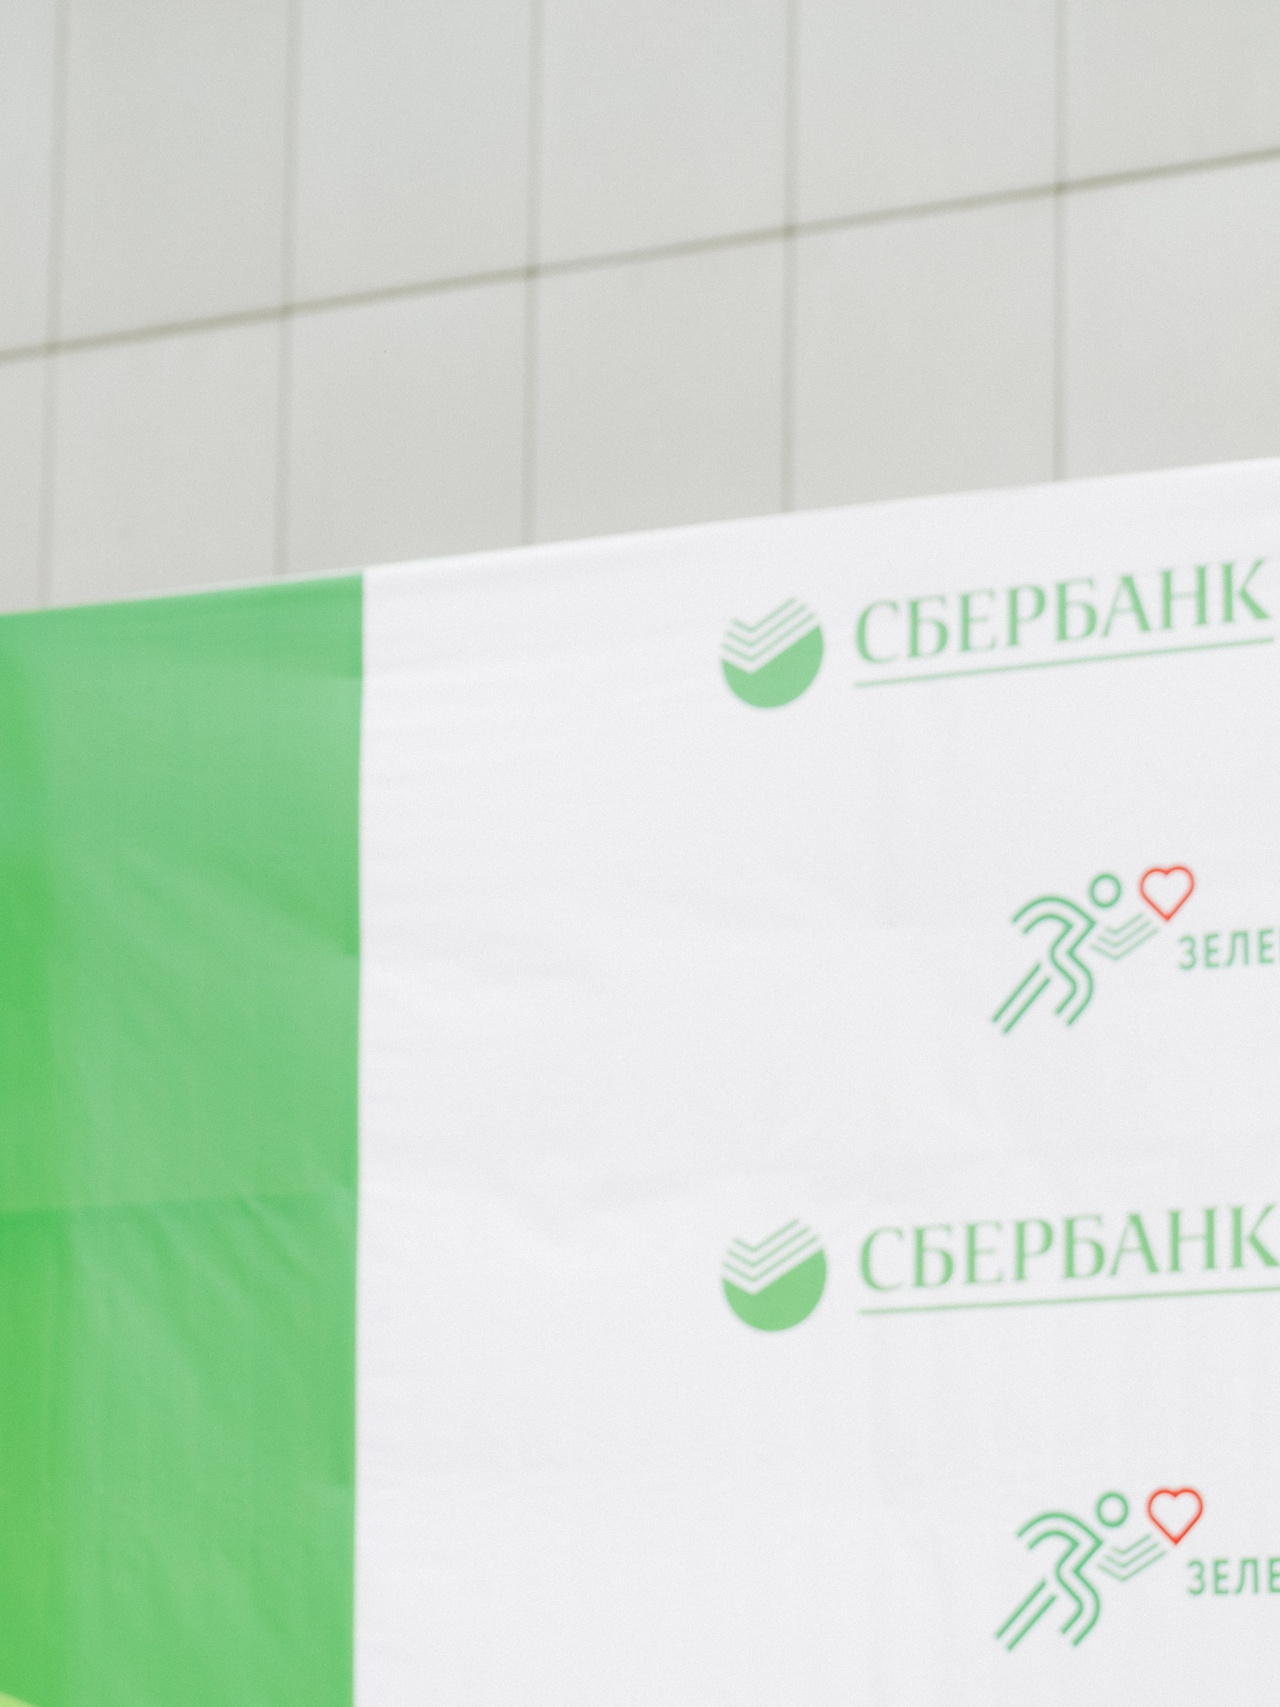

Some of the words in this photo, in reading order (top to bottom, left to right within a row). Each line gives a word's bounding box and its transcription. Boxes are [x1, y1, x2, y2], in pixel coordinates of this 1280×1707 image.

[854, 556, 1272, 666] СБЕРБАНК
[1178, 927, 1280, 971] ЗЕЛЕ
[858, 1203, 1280, 1293] СБЕРБАНК
